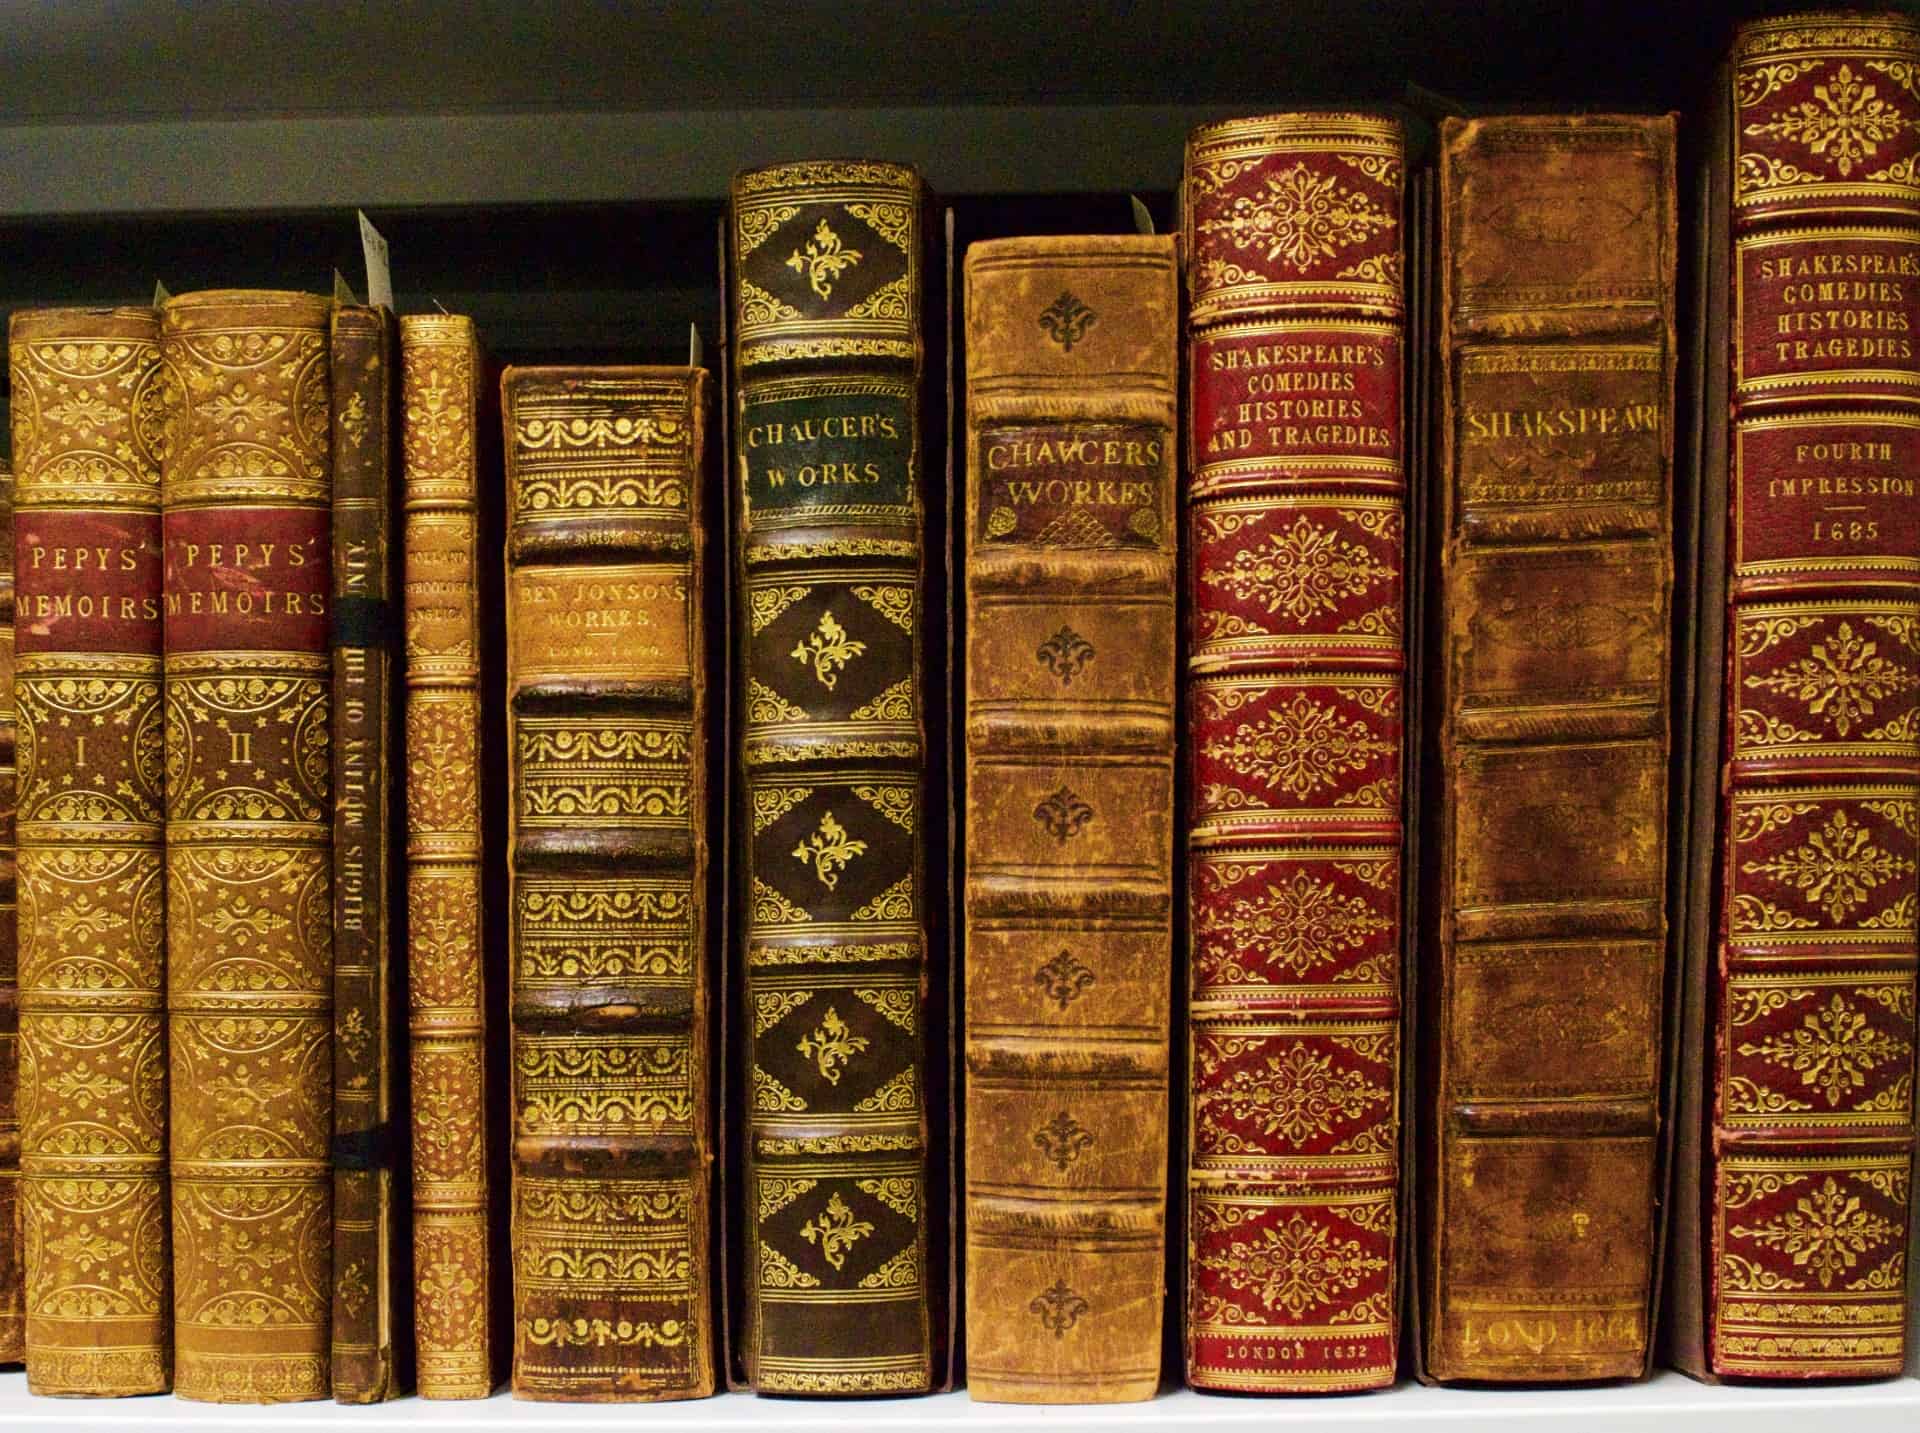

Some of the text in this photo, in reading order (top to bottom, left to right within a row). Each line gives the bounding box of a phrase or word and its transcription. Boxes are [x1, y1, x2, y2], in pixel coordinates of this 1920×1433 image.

[1783, 282, 1903, 304] COMEDIES
[1777, 310, 1909, 333] HISTORIES
[1212, 345, 1385, 371] SHAKESPEARE'S
[1776, 338, 1912, 362] TRAGEDIES
[1248, 372, 1355, 394] COMEDIES
[1238, 399, 1362, 423] HISTORIES
[1208, 424, 1390, 452] AND TRAGEDIES
[1796, 442, 1892, 463] FOURTH
[768, 463, 880, 488] WORKS
[1769, 477, 1914, 497] IMPRESSION
[1008, 480, 1153, 505] WORKES
[1813, 521, 1878, 541] 1685
[31, 541, 146, 570] PEPYS'
[186, 537, 316, 567] PEPYS'
[168, 591, 325, 616] MEMOIRS
[520, 581, 687, 604] BEN JONSON'S
[16, 595, 158, 620] MEMOIRS
[345, 702, 365, 723] OF
[229, 732, 252, 764] II
[344, 738, 366, 826] MUTINY
[343, 845, 364, 931] BLIGH'S
[1226, 1344, 1368, 1360] LONDON 1632
